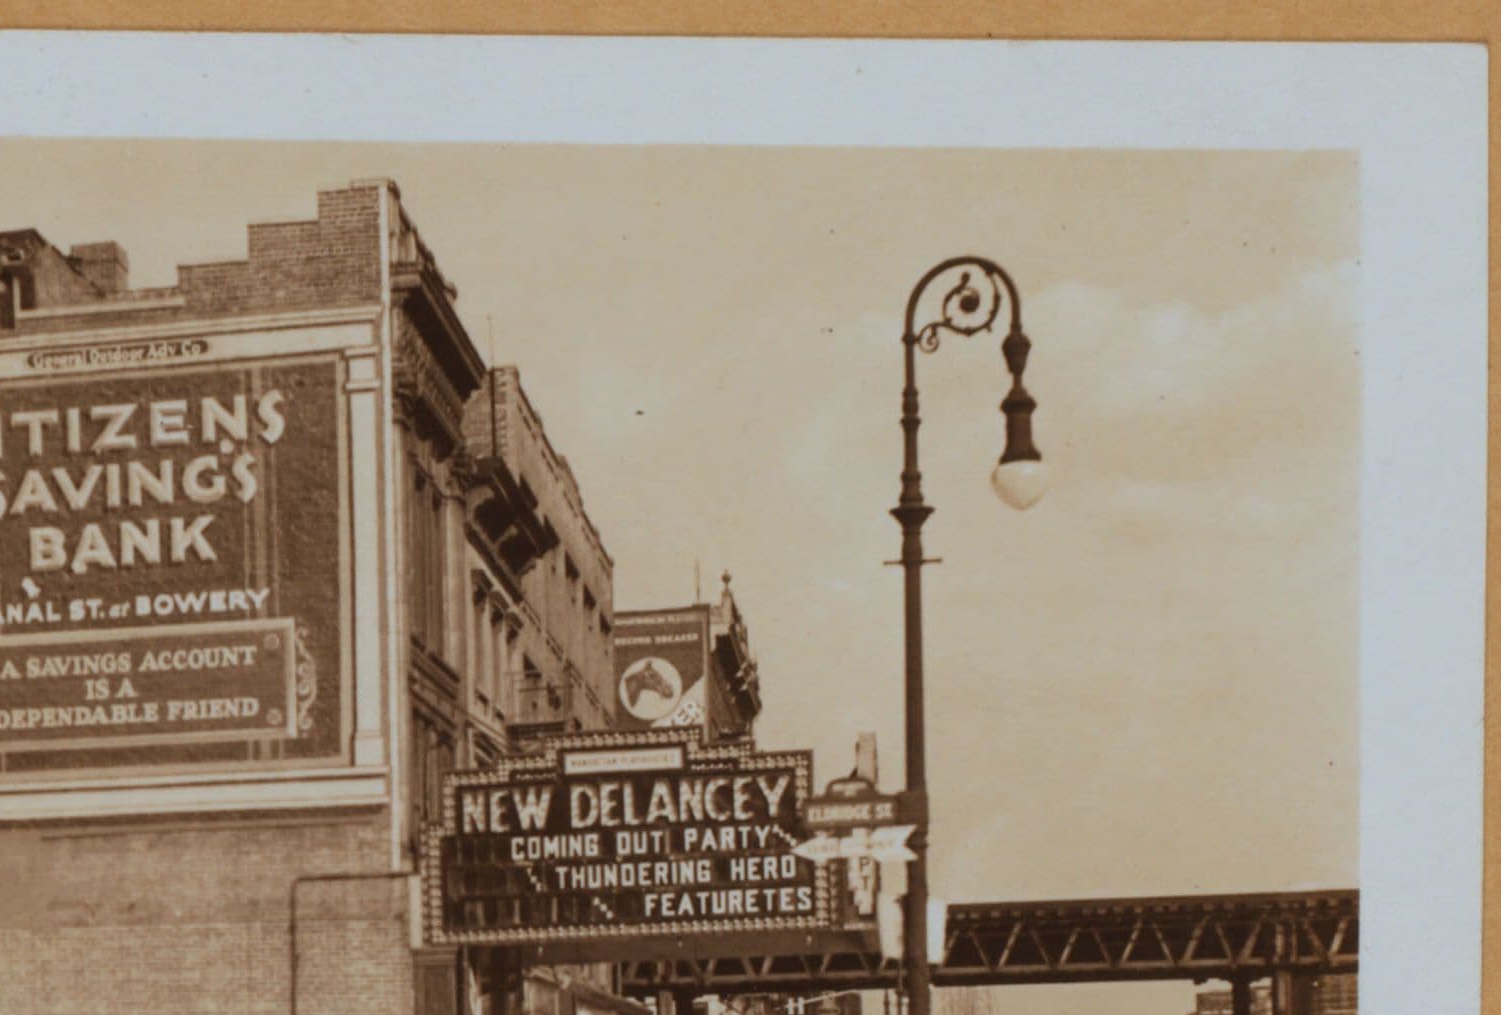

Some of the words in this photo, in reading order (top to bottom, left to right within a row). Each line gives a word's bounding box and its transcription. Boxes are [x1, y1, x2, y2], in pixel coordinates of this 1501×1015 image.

[29, 513, 218, 573] BANK
[70, 599, 104, 621] ST.
[109, 601, 130, 619] at
[135, 589, 271, 617] BOWERY
[0, 661, 20, 680] A
[26, 653, 132, 679] SAVINGS
[138, 645, 258, 672] ACCOUNT
[85, 680, 110, 700] IS
[114, 680, 138, 699] A
[168, 697, 260, 722] FRIEND
[462, 786, 551, 833] NEW
[570, 775, 790, 829] DELANCEY
[511, 834, 599, 862] COMING
[616, 830, 664, 855] OUT
[683, 825, 772, 851] PARTY
[556, 858, 712, 890] THUNDERING
[730, 854, 797, 881] HERD
[645, 887, 812, 917] FEATURETES
